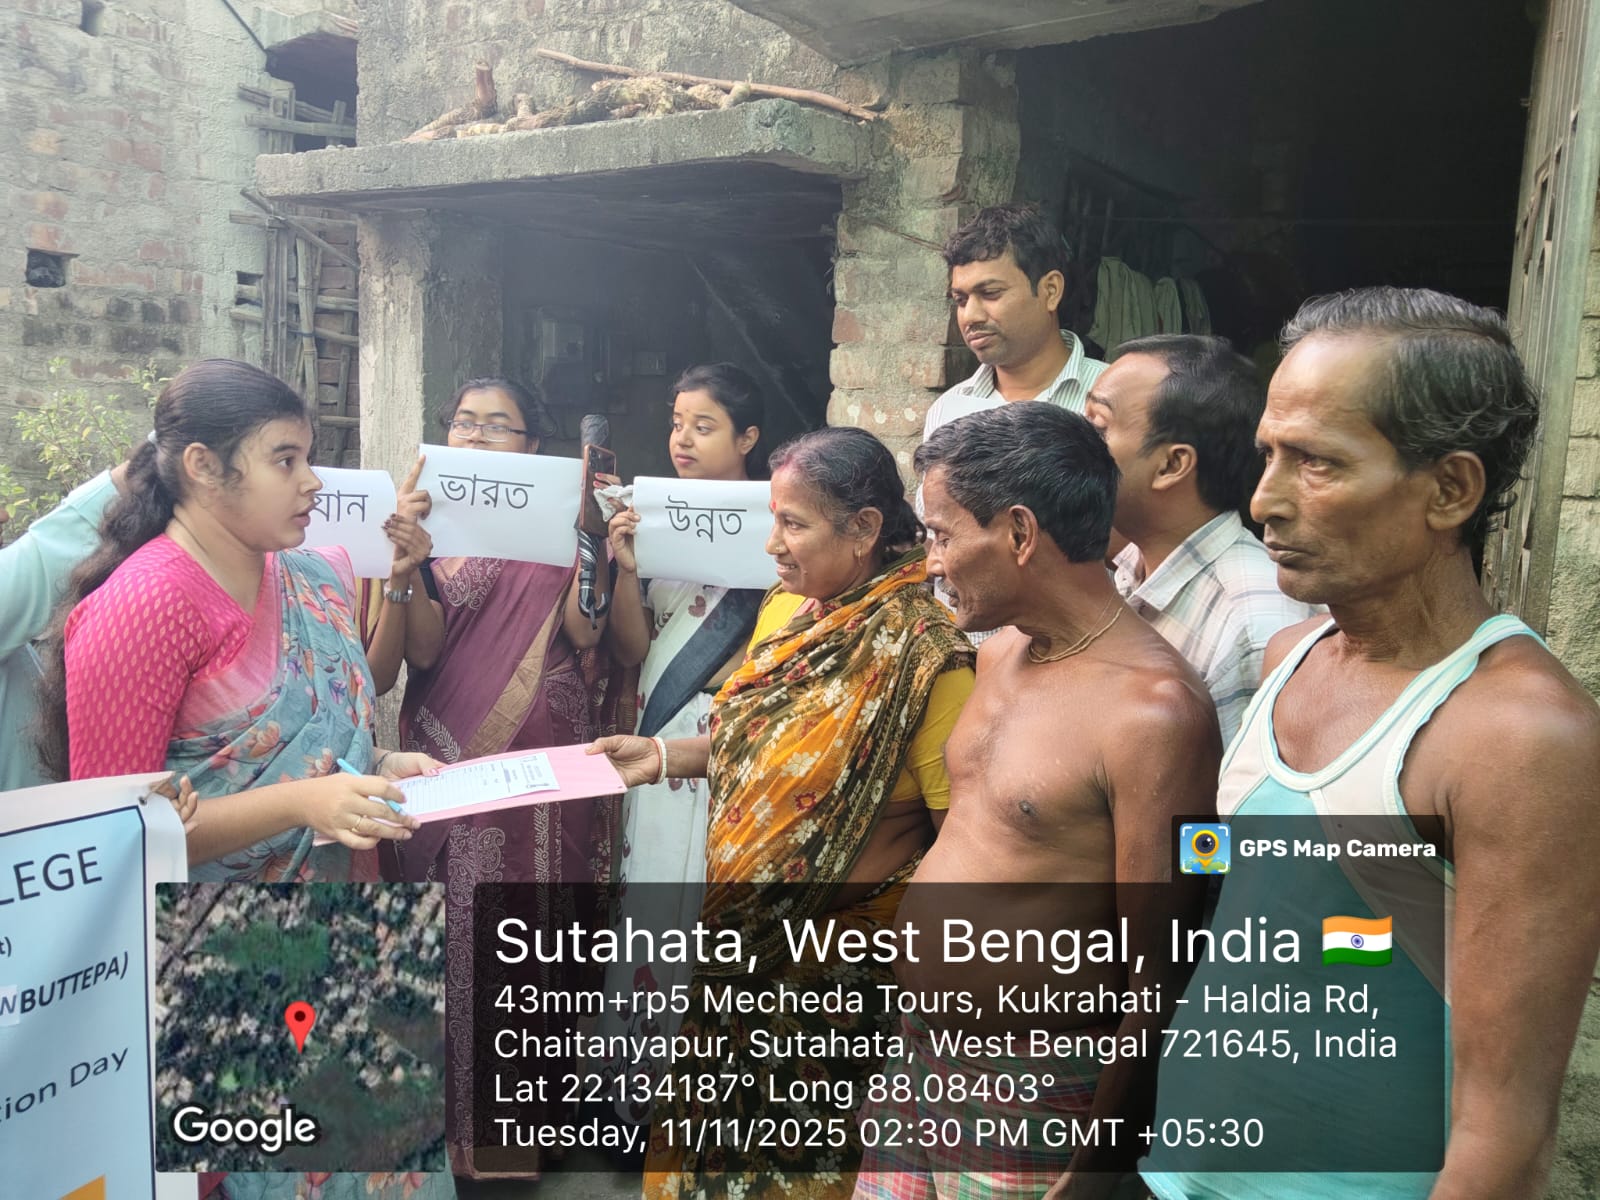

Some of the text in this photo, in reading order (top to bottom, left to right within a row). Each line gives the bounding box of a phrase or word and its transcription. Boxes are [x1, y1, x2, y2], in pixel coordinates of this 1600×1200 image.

[438, 473, 535, 509] ভারত
[664, 495, 747, 542] উন্নত
[0, 1048, 129, 1123] ion Day
